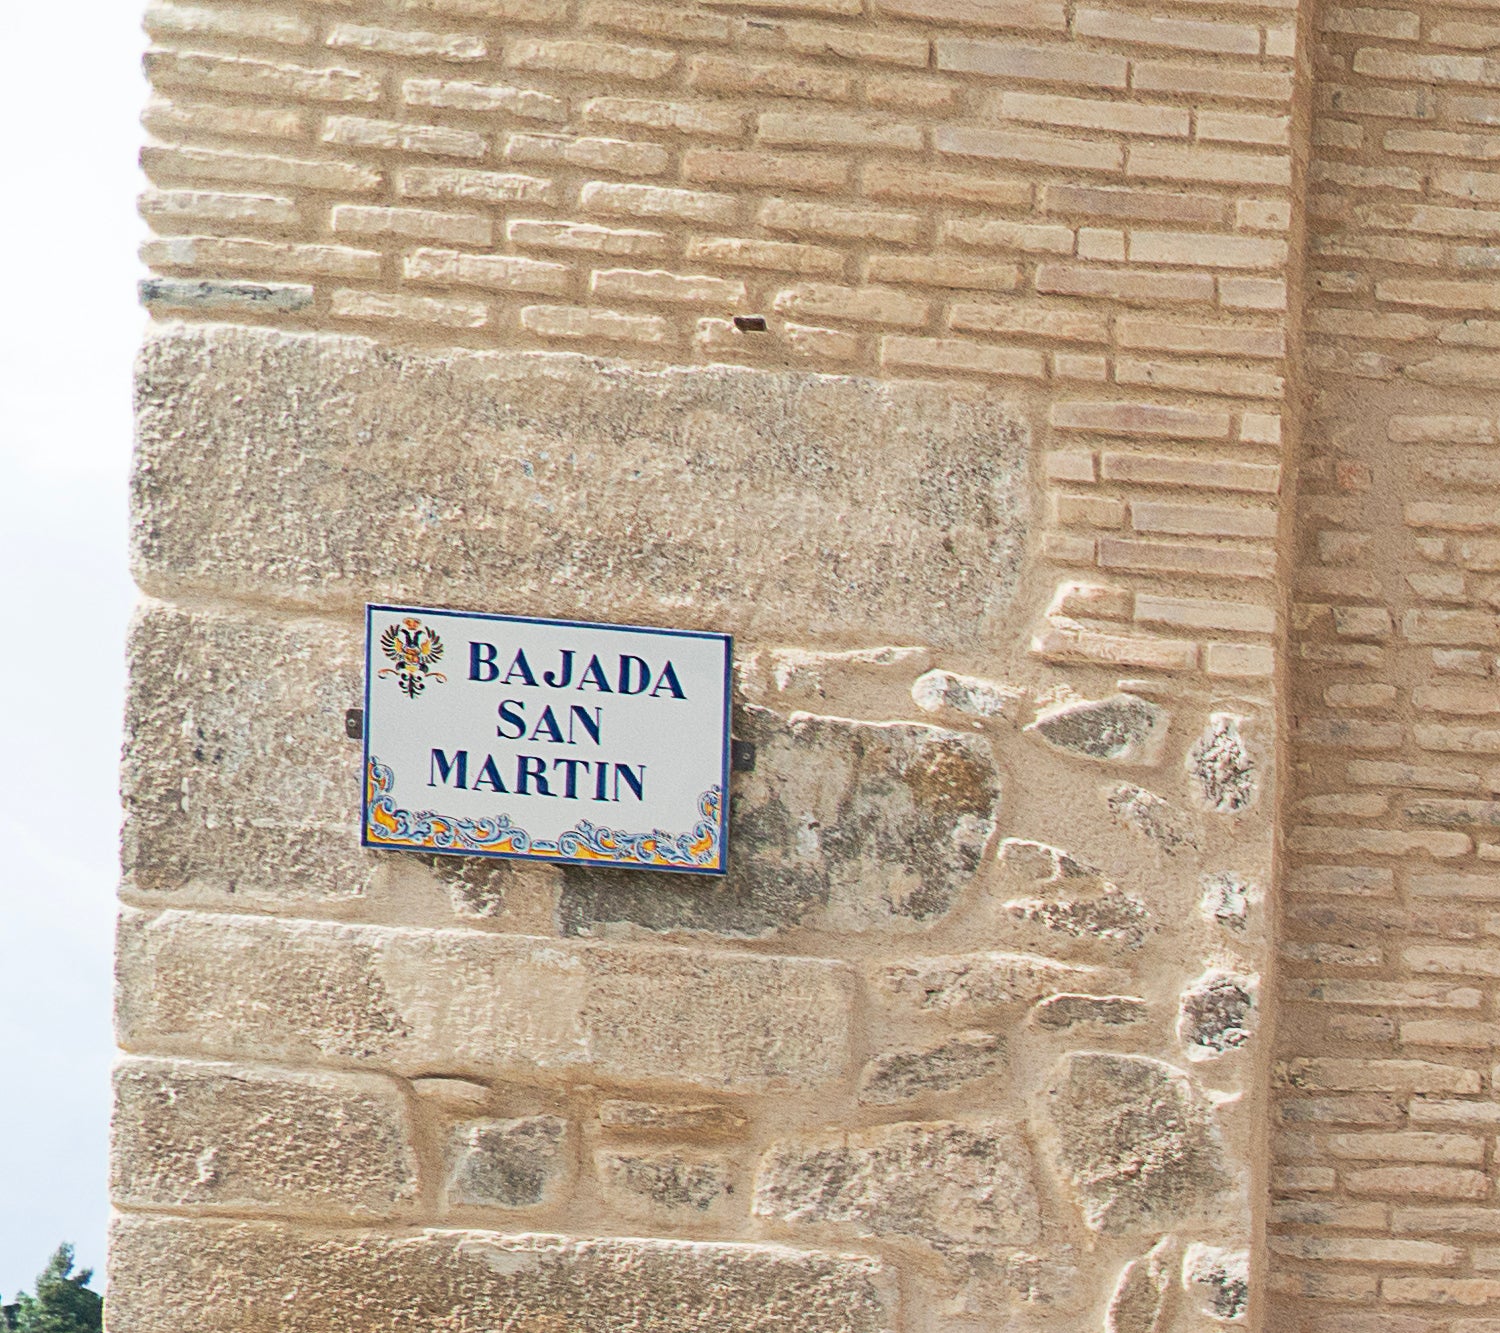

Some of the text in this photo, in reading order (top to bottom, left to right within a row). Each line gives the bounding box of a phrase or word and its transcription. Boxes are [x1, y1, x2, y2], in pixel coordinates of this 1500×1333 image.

[468, 641, 687, 699] BAJADA
[497, 700, 602, 745] SAN
[427, 749, 646, 802] MARTIN
